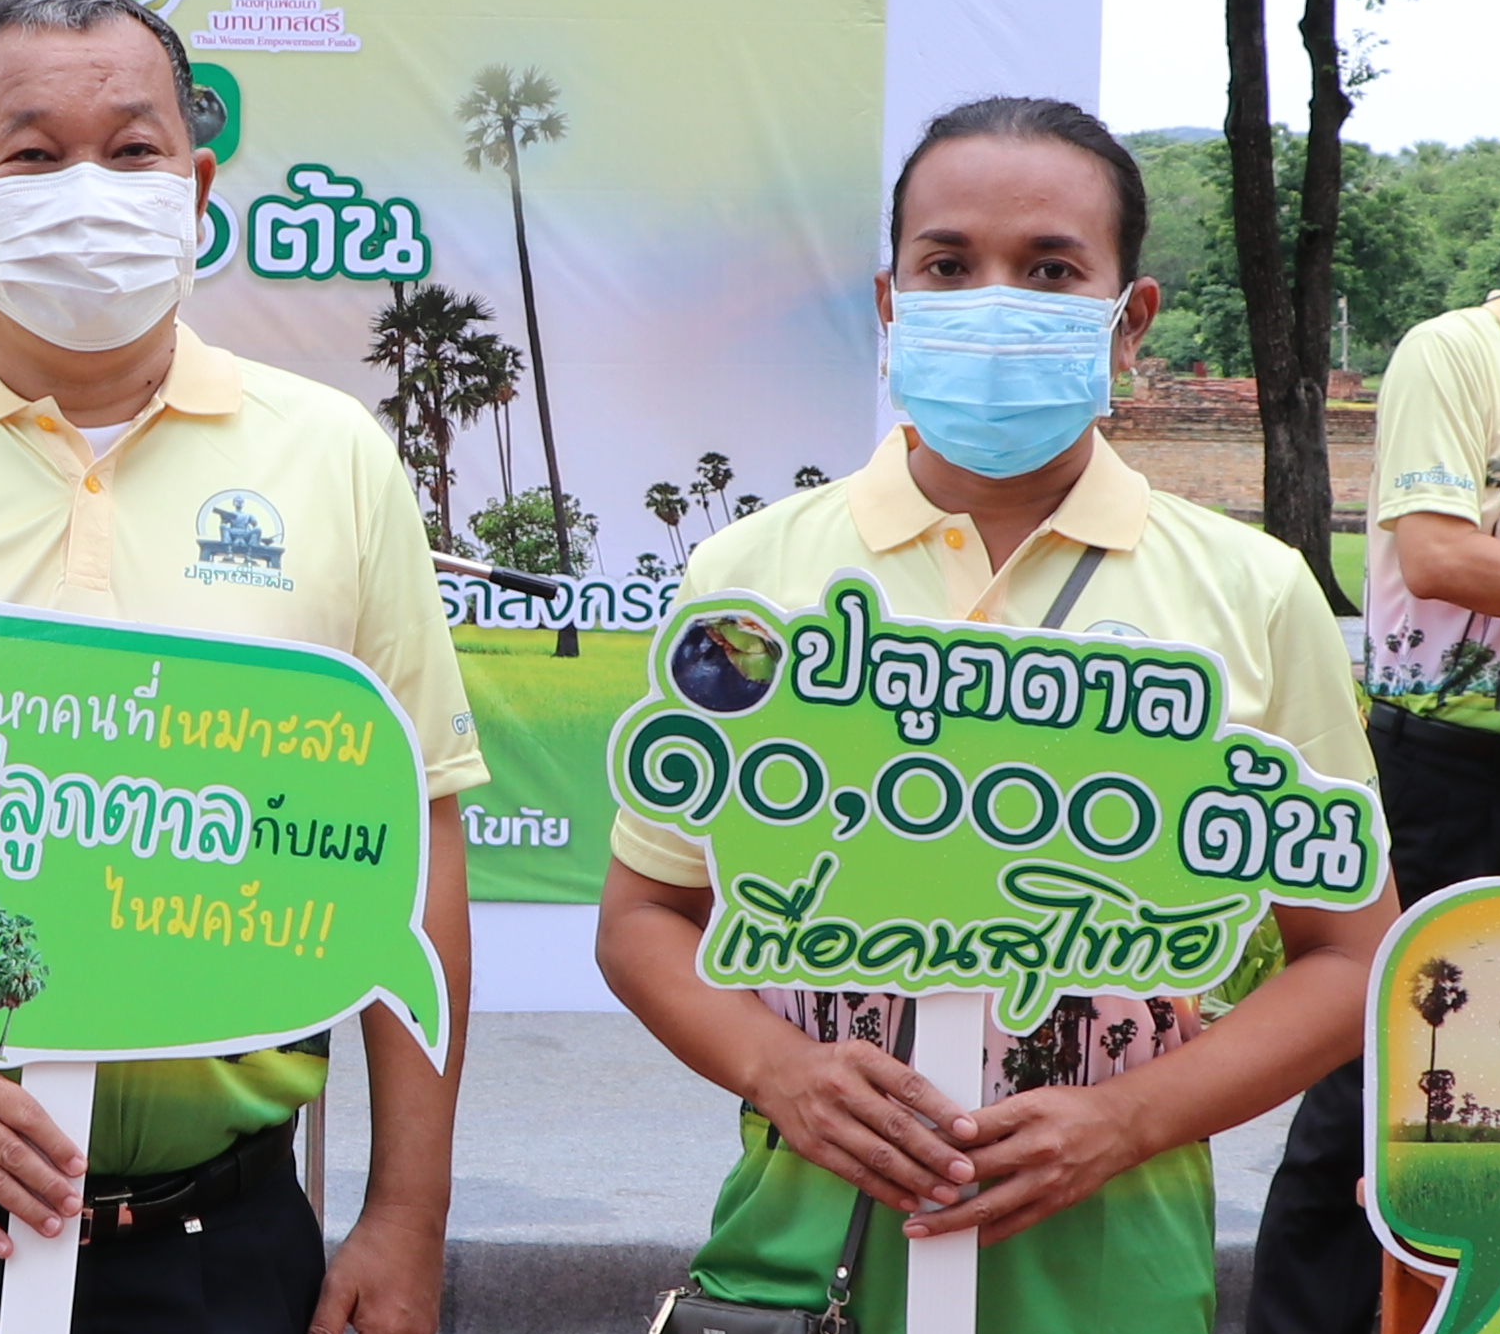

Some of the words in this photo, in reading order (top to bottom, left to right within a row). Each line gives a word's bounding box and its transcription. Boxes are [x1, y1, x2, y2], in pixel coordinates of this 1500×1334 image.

[195, 35, 217, 45] Thai
[219, 36, 255, 46] Women
[257, 36, 326, 48] Empowerment
[328, 38, 357, 48] Funds
[213, 12, 341, 33] บทบาทสตรี
[248, 163, 430, 281] ต้น
[184, 562, 294, 592] ปลูกเพื่อพ่อ
[794, 589, 1211, 744] ปลูกตาล
[460, 804, 570, 847] โขทัย
[628, 713, 1158, 857] ๑๐,๐๐๐
[1178, 744, 1368, 893] ต้น
[104, 866, 336, 959] ไหมครับ!!
[716, 857, 1250, 1019] เพื่อคนสุโขทัย
